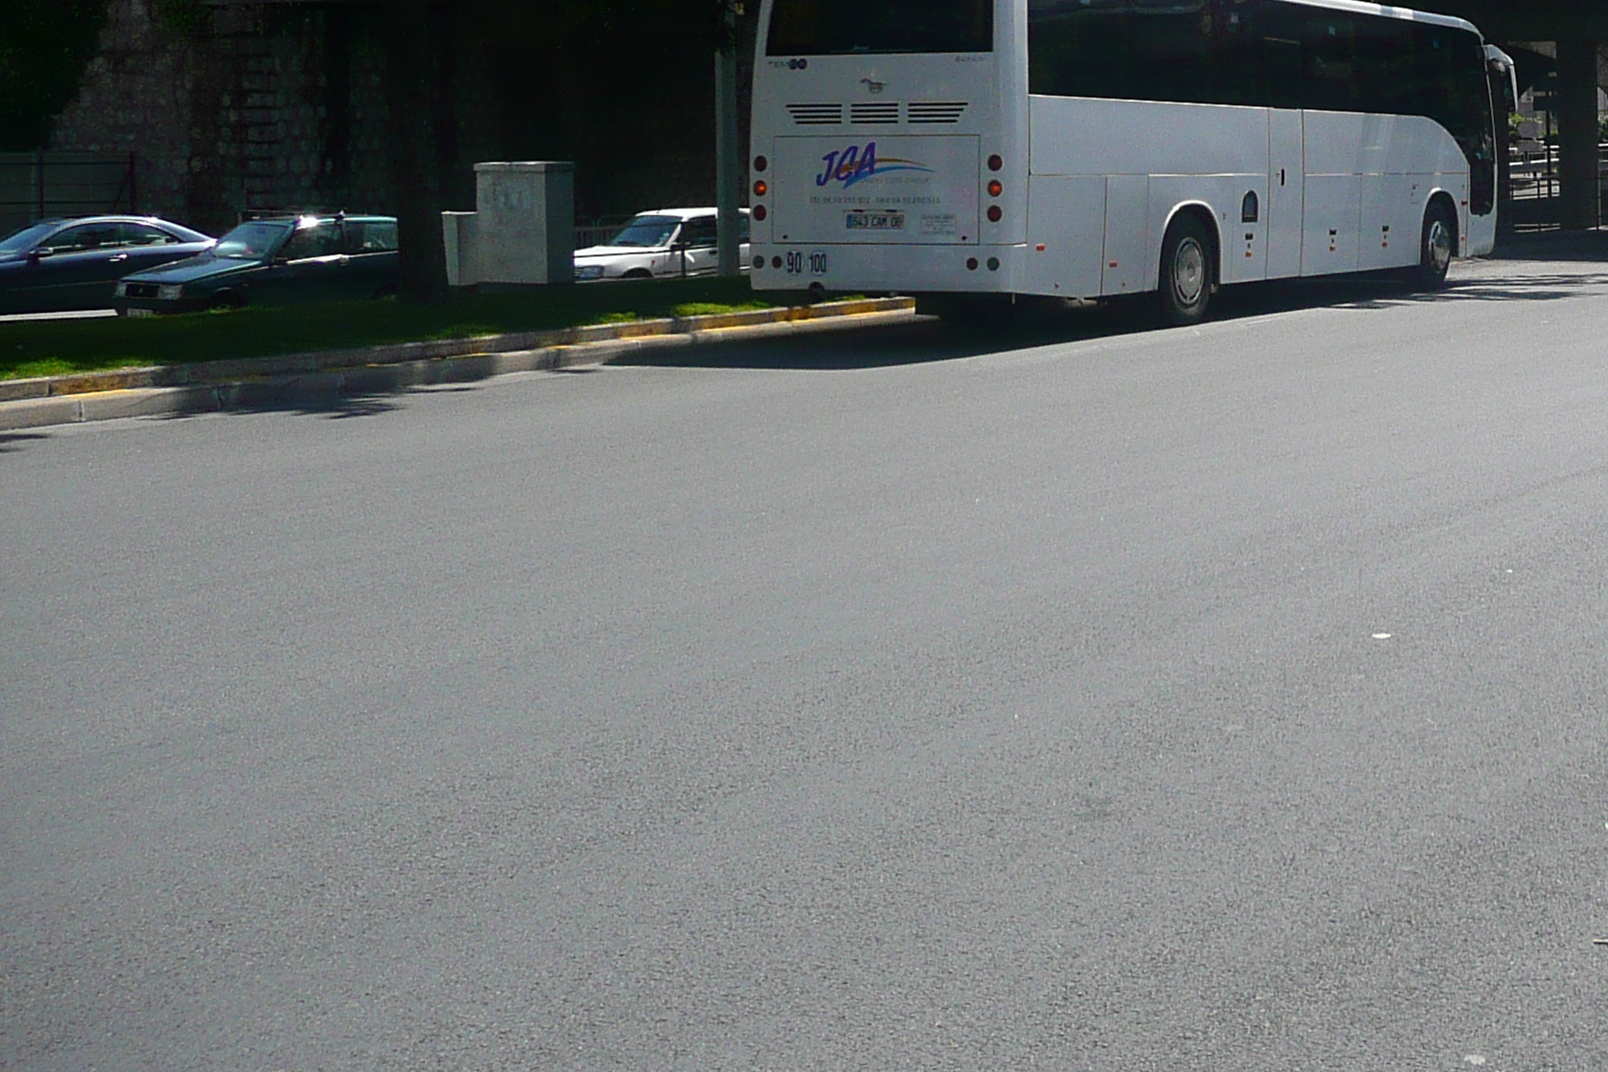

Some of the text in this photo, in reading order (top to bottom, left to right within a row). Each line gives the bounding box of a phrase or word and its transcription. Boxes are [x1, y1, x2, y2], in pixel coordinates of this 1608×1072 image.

[816, 141, 876, 187] JCA
[787, 252, 802, 273] 90
[808, 253, 827, 273] 100
